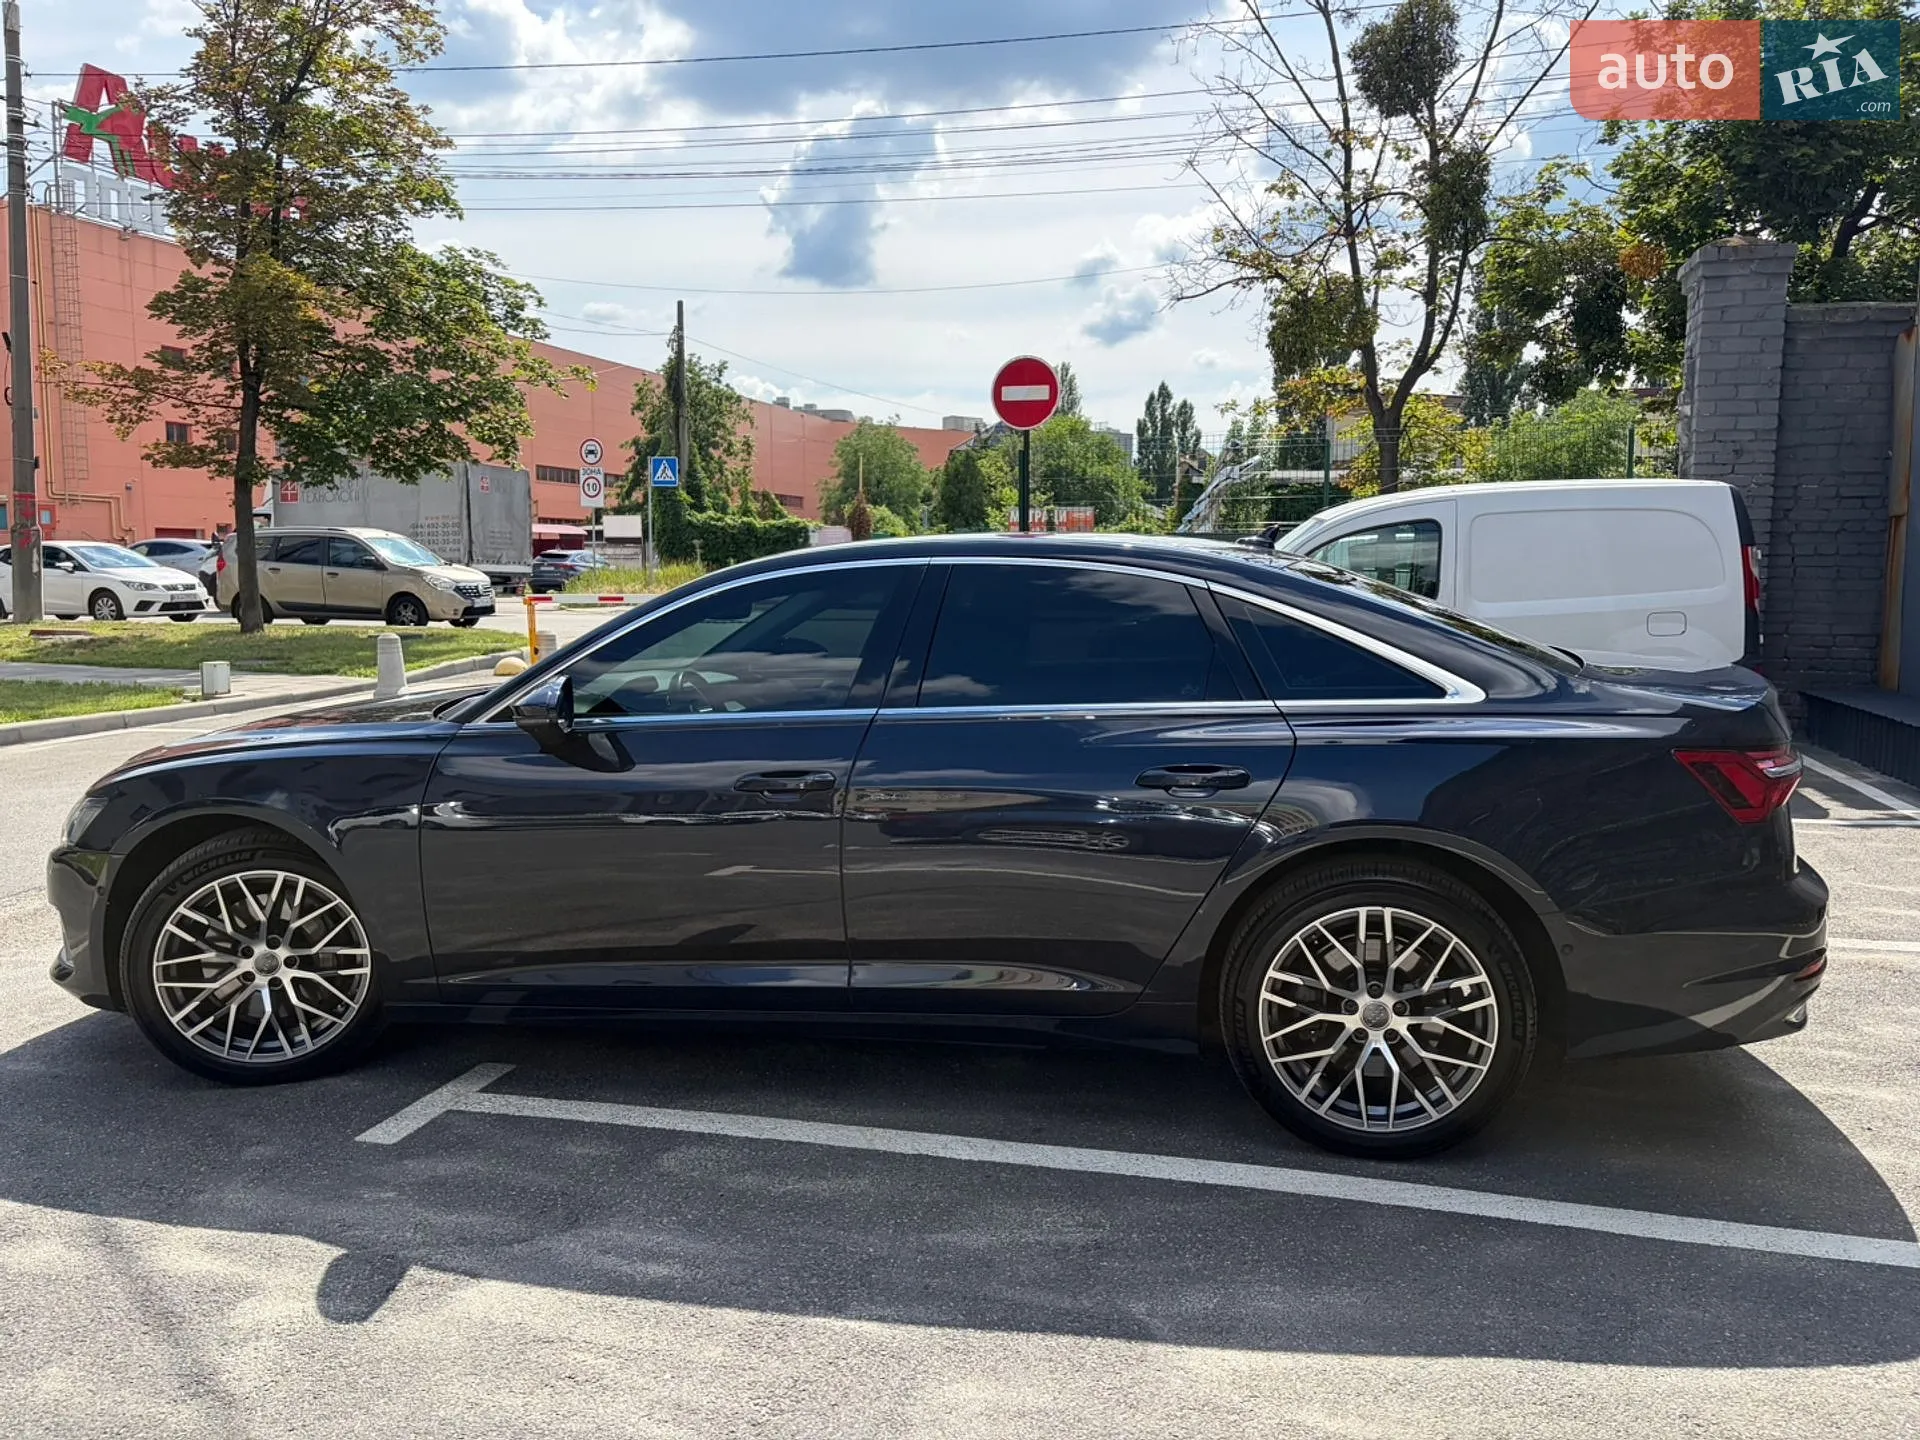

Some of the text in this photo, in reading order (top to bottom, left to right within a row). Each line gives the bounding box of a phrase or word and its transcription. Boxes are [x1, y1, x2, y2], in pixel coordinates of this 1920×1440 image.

[582, 467, 601, 476] ЗОНА
[586, 482, 598, 492] 10
[182, 852, 250, 882] MICHELIN
